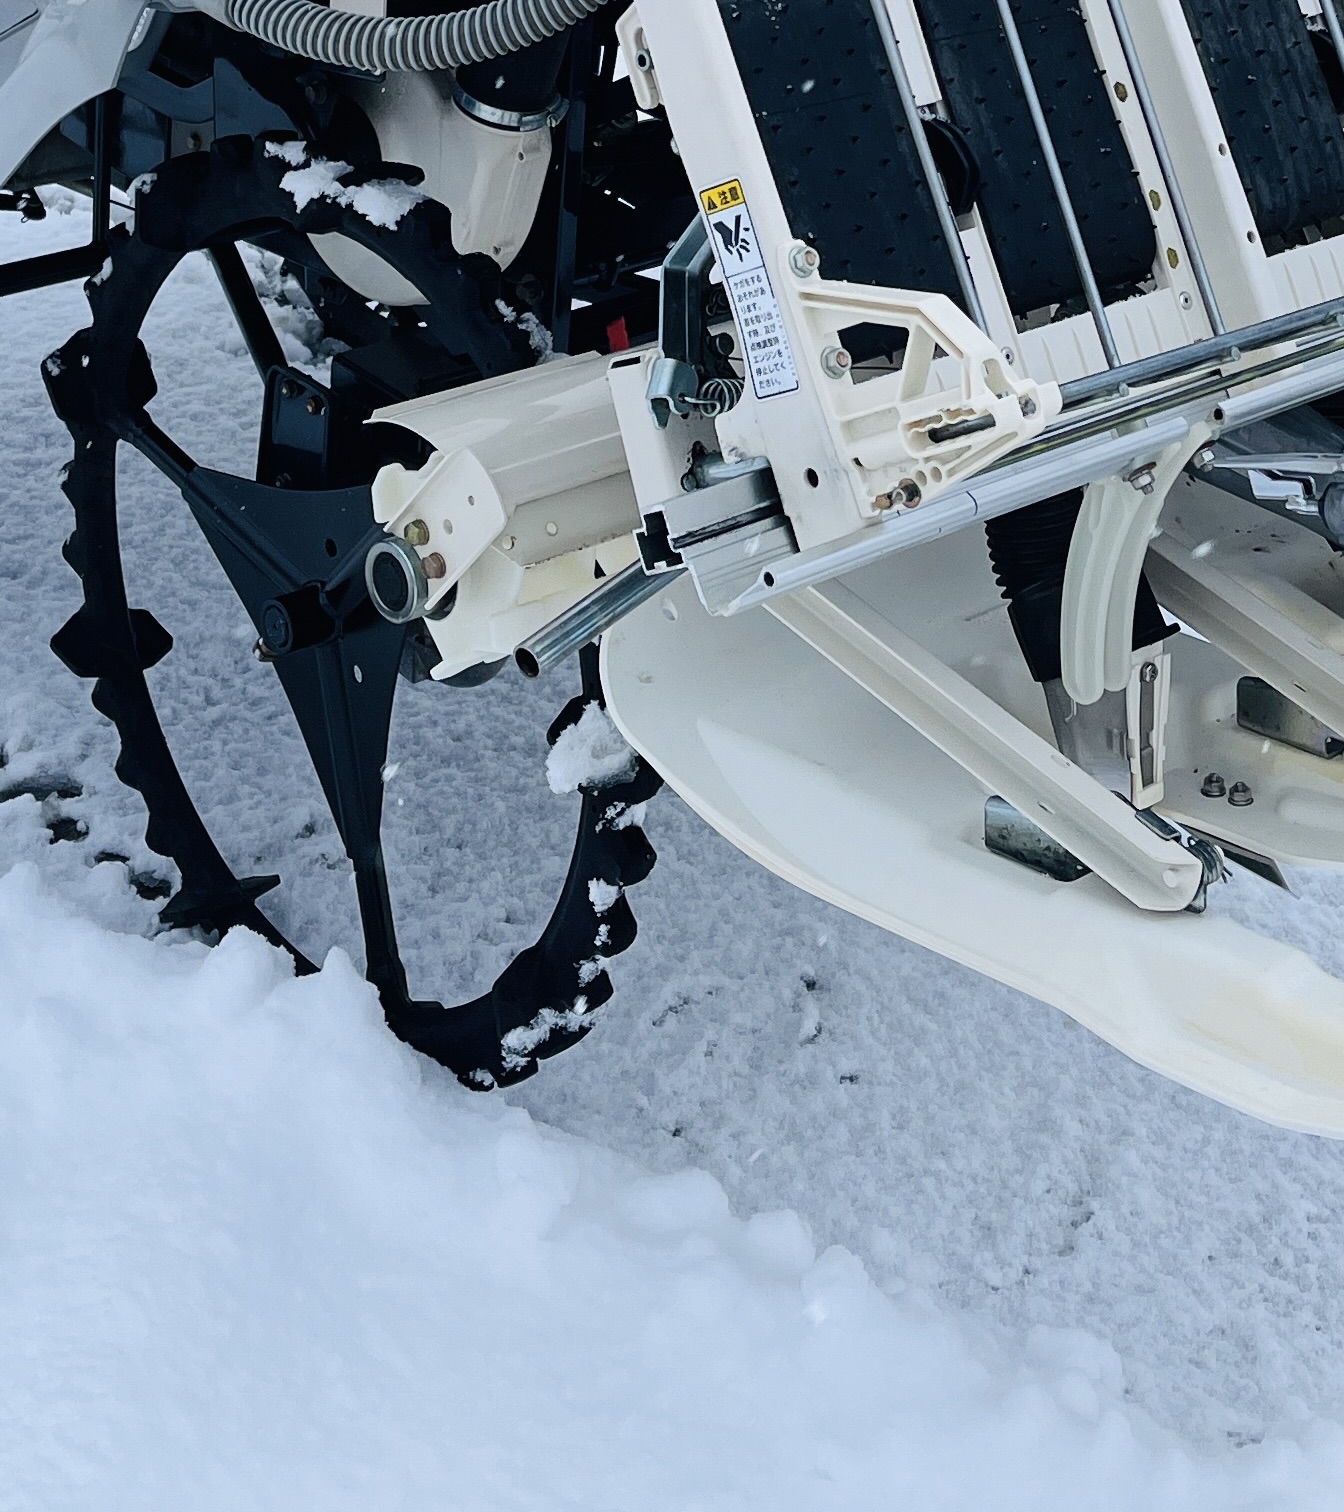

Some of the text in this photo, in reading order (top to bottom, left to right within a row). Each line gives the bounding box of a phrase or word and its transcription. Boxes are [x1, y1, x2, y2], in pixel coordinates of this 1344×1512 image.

[717, 186, 740, 205] 注意
[733, 274, 763, 289] ケガをする
[753, 348, 783, 364] エンジンを
